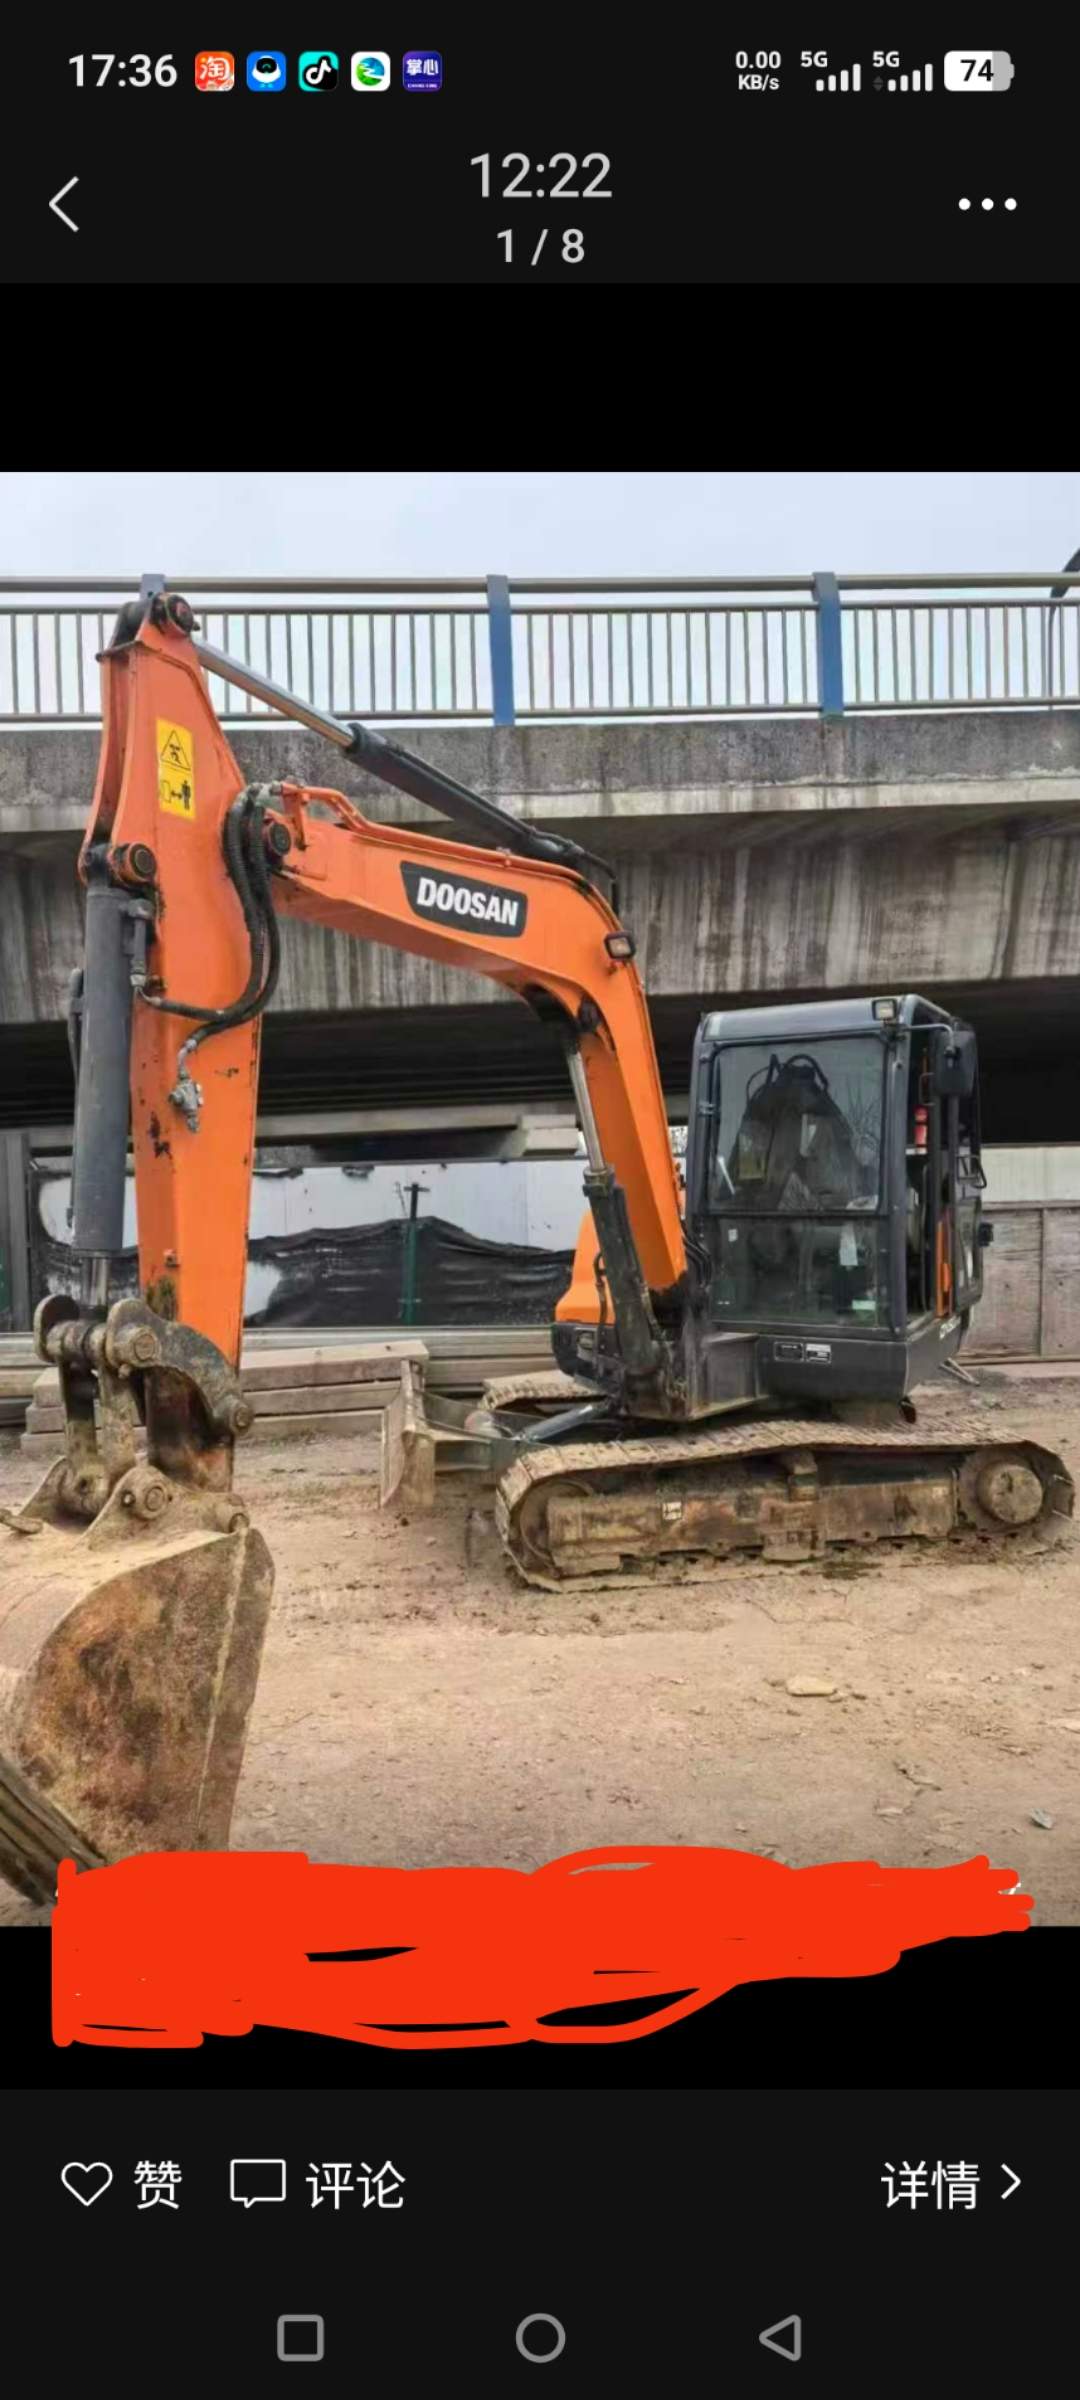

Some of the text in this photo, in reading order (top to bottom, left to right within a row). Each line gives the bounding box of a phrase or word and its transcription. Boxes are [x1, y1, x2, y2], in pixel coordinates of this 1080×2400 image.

[69, 54, 177, 87] 17:36
[200, 57, 230, 80] 淘
[406, 58, 439, 76] 掌心
[736, 51, 781, 69] 0.00
[801, 51, 828, 67] 5G
[873, 51, 900, 67] 5G
[960, 59, 994, 82] 74
[738, 74, 780, 91] KB/s
[470, 153, 612, 198] 12:22
[497, 229, 513, 263] 1
[562, 229, 585, 264] 8
[417, 877, 518, 926] DOOSAN
[134, 2160, 182, 2209] 赞
[306, 2161, 405, 2210] 评论
[881, 2160, 980, 2209] 详情
